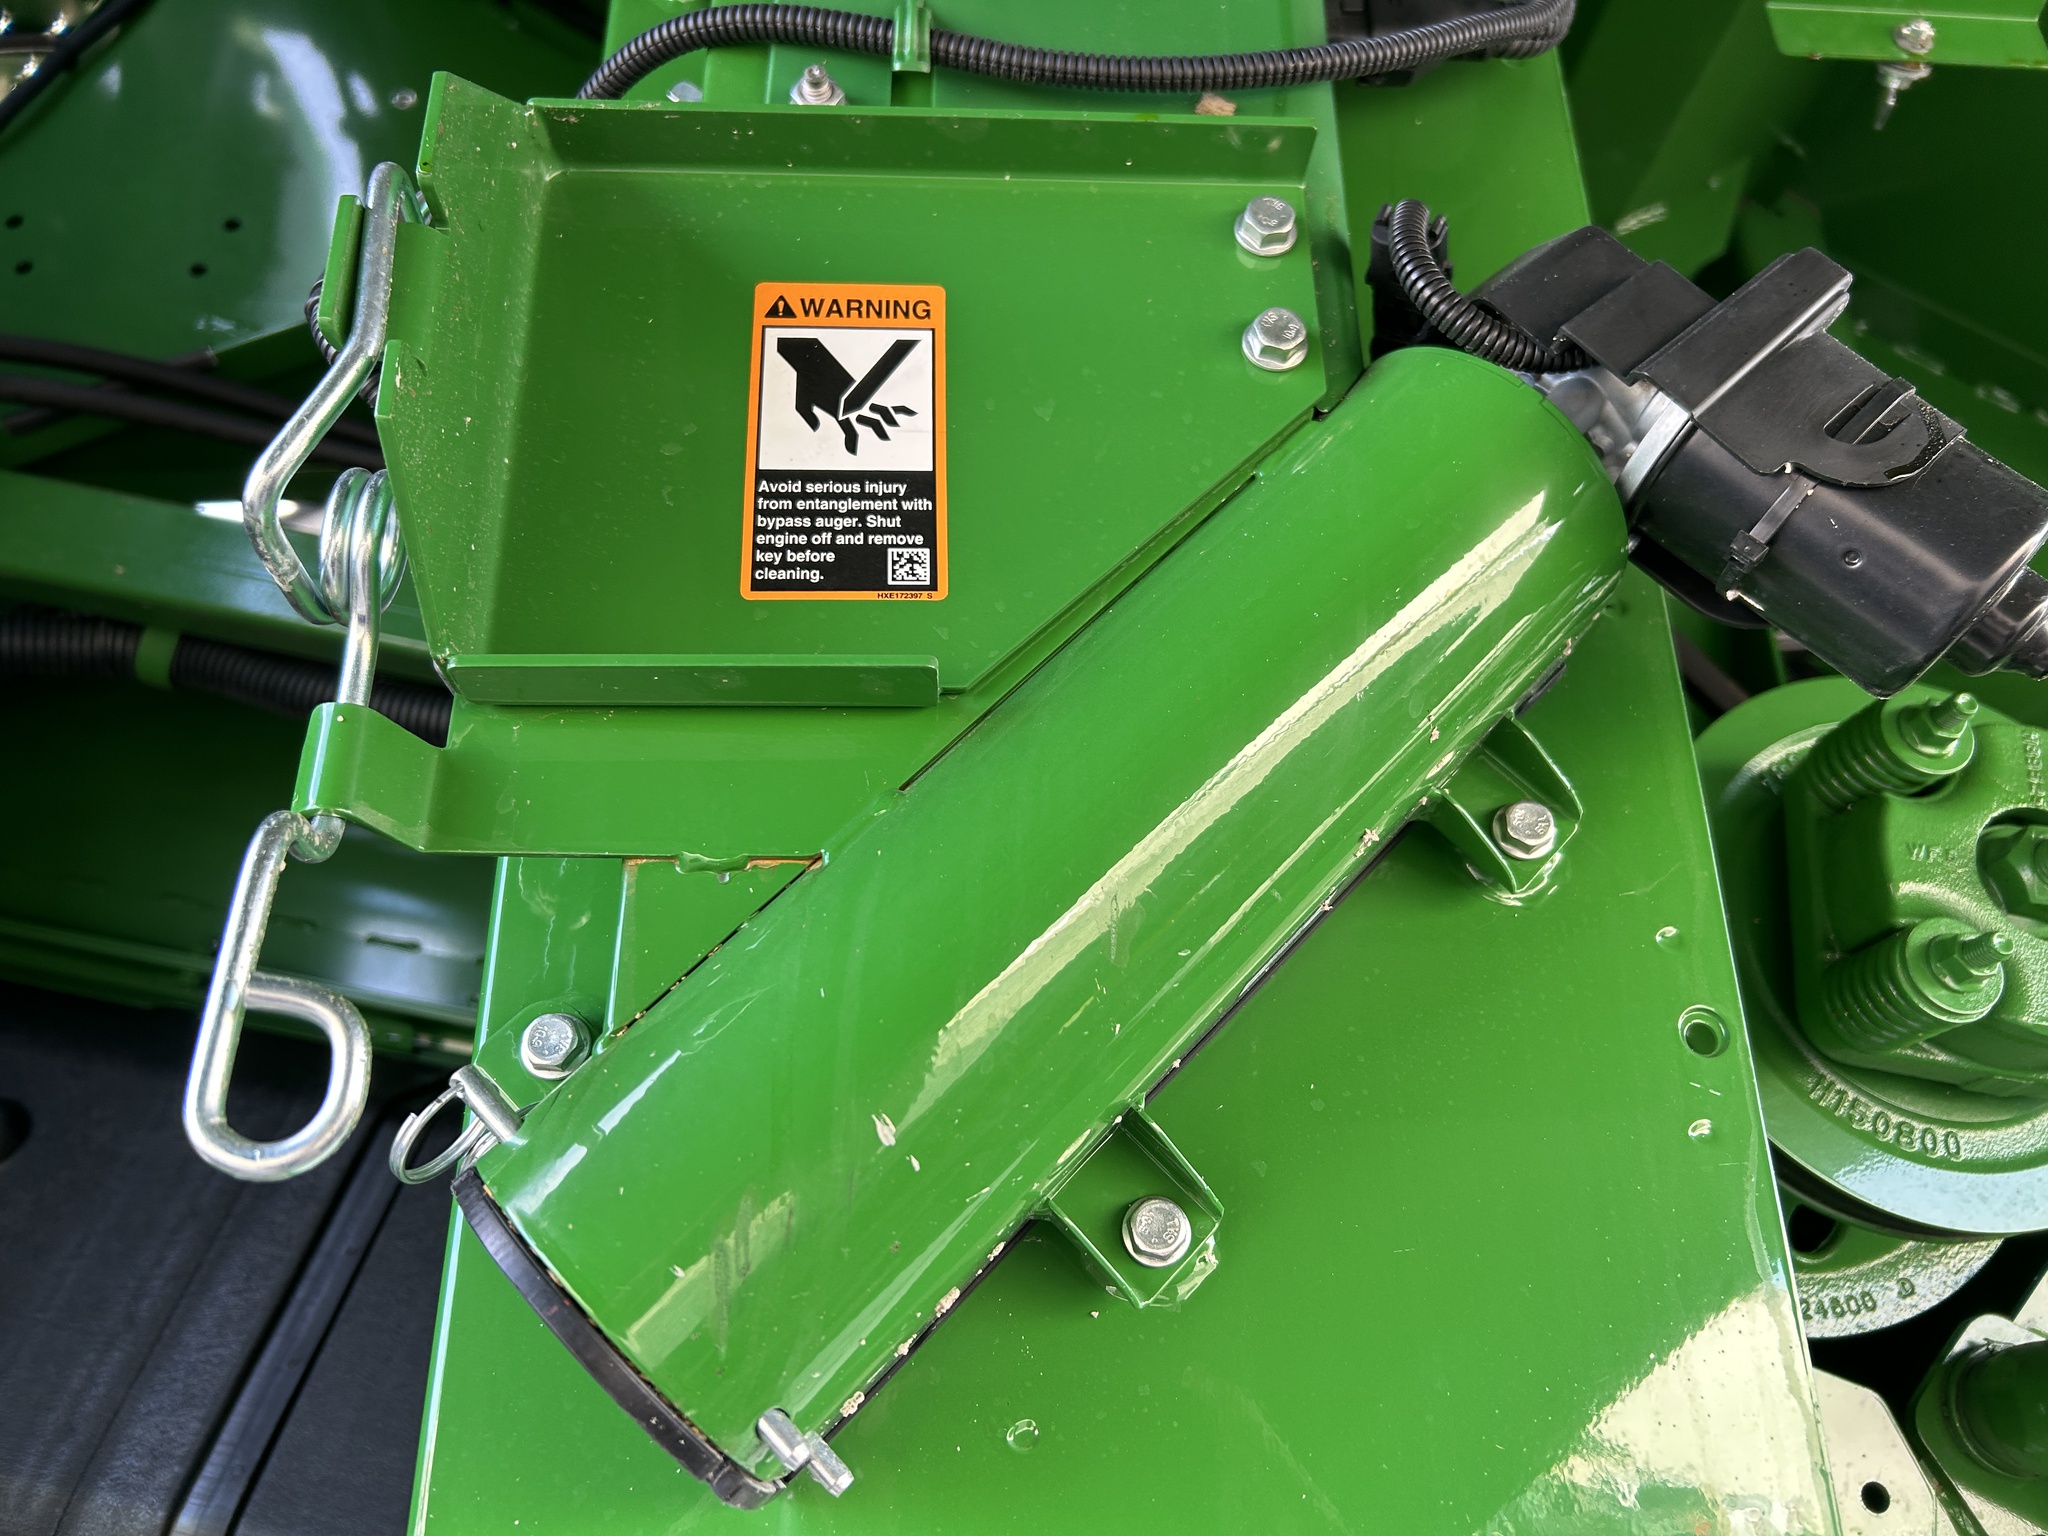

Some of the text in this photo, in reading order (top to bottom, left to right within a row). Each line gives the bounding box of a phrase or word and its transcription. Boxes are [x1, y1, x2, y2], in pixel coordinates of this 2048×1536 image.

[800, 298, 931, 320] WARNING
[758, 480, 907, 496] Avoid serious injury
[757, 498, 933, 513] from entanglement with
[757, 515, 902, 530] bypass auger. Shut
[756, 532, 924, 547] engine off and remove
[755, 549, 836, 565] key before
[754, 567, 825, 583] cleaning.
[877, 592, 933, 600] HXE172397 S
